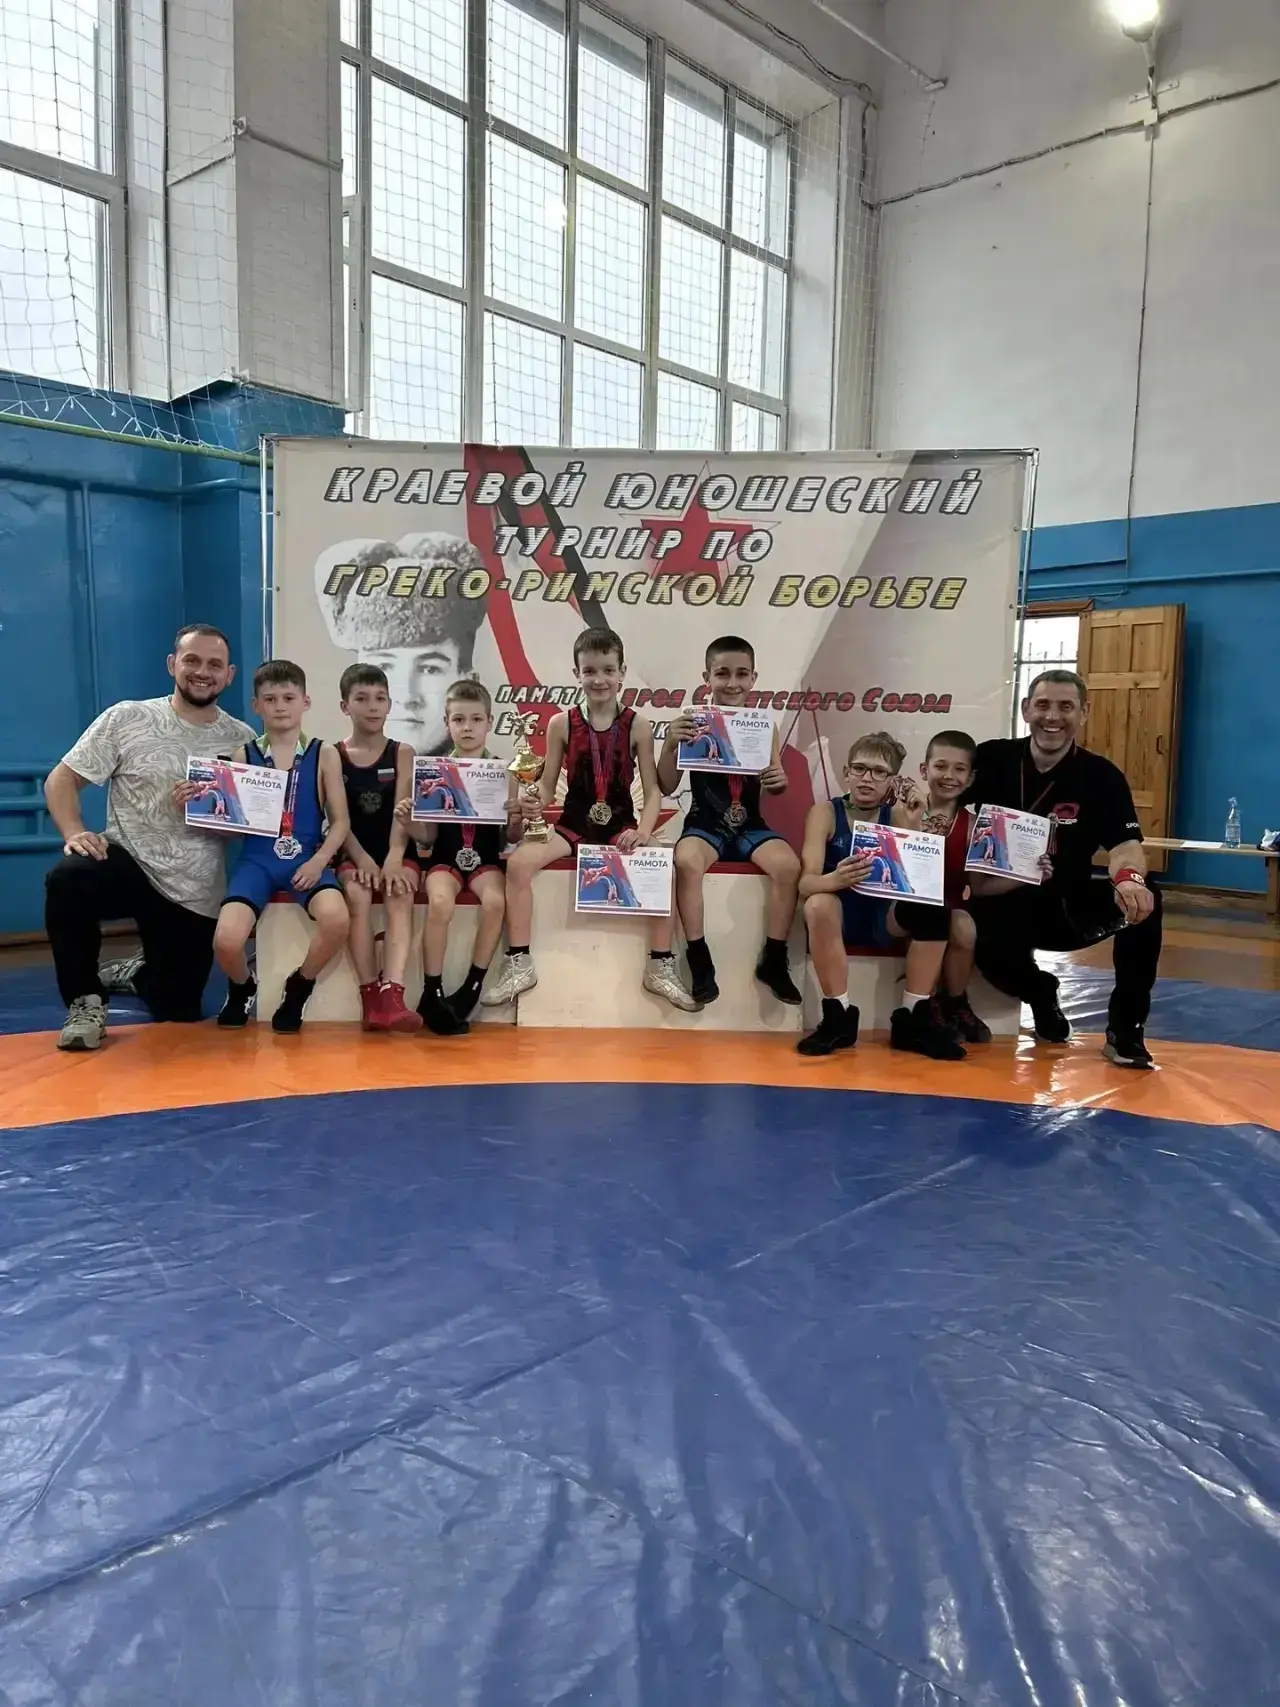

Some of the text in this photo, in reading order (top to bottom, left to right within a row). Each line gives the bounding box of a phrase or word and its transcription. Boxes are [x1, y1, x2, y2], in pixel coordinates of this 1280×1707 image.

[324, 461, 982, 515] КРАЕВОЙ ЮНОШЕСКИЙ
[495, 526, 773, 562] ТУРНИР ПО
[324, 565, 967, 610] ГРЕКО-РИМСКОЙ БОРЬБЕ
[619, 683, 686, 708] ероя
[861, 687, 952, 713] Союза
[730, 720, 770, 729] ГРАМОТА
[466, 771, 506, 779] ГРАМОТА
[240, 776, 282, 790] ГРАМОТА
[1011, 823, 1046, 837] ГРАМОТА
[903, 842, 941, 856] ГРАМОТА
[629, 859, 669, 868] ГРАМОТА
